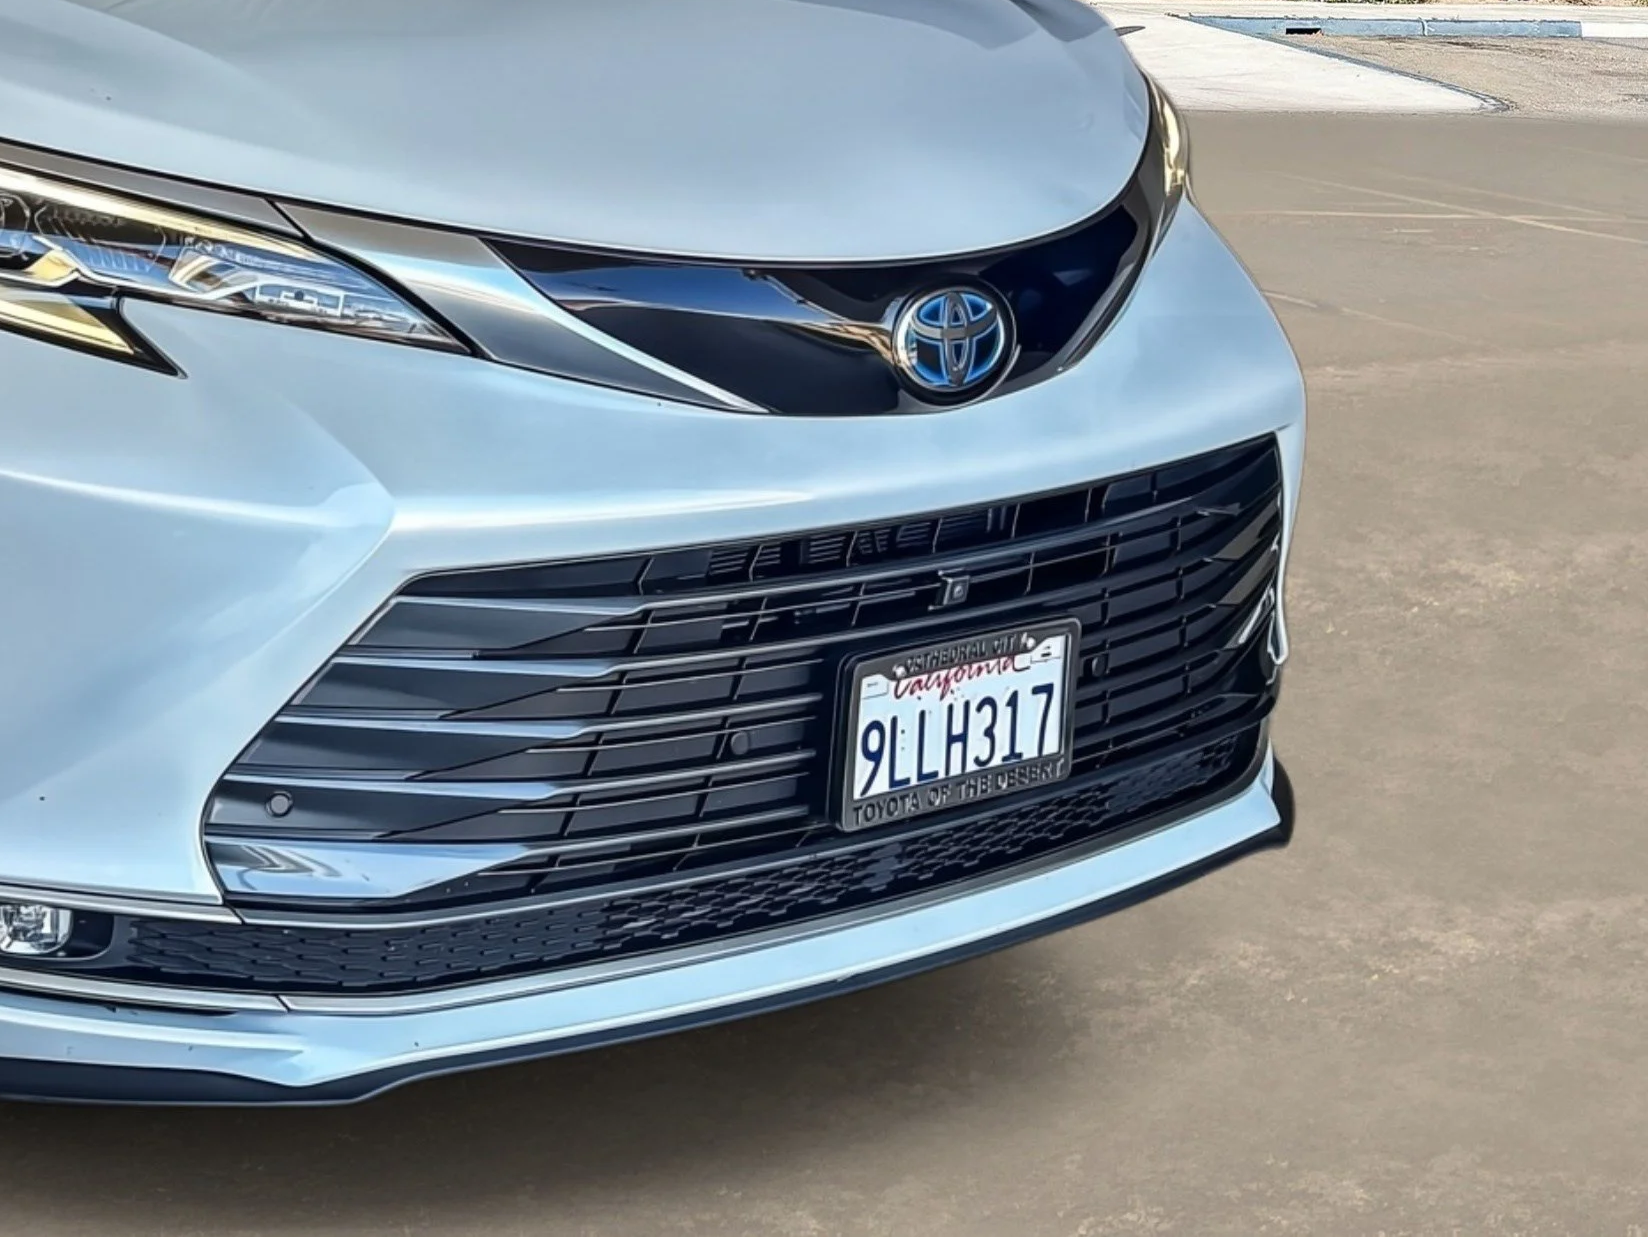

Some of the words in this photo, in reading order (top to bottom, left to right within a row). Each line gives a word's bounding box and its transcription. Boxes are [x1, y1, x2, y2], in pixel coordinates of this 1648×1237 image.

[893, 653, 1031, 701] California
[861, 683, 1054, 796] 9LLH317
[853, 792, 921, 826] TOYOTA
[927, 784, 952, 807] OF
[956, 774, 992, 798] THE
[996, 758, 1065, 789] DESERT
